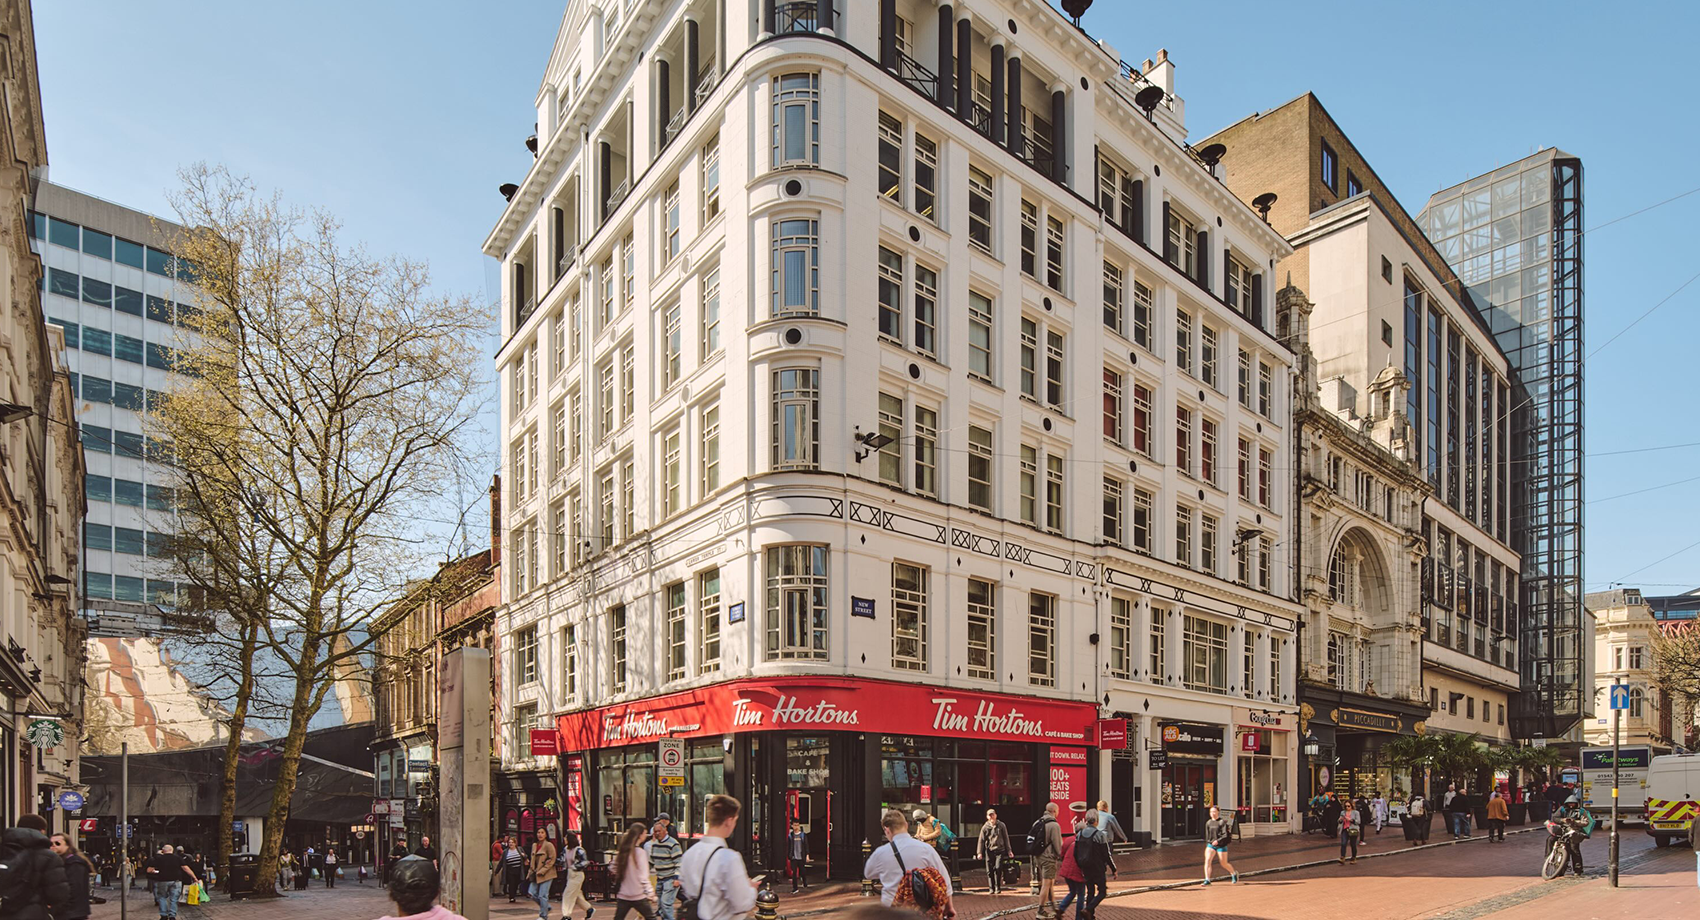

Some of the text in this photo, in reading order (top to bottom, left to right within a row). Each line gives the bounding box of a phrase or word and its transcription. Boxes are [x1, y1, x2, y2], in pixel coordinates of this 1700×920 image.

[732, 698, 761, 726] Tim
[931, 698, 969, 732] Tim
[603, 712, 621, 741] Tim
[1354, 714, 1385, 727] PICCADILLY
[1044, 730, 1057, 738] CAFÉ
[1070, 752, 1086, 760] RELAX.
[808, 768, 829, 776] SHOP
